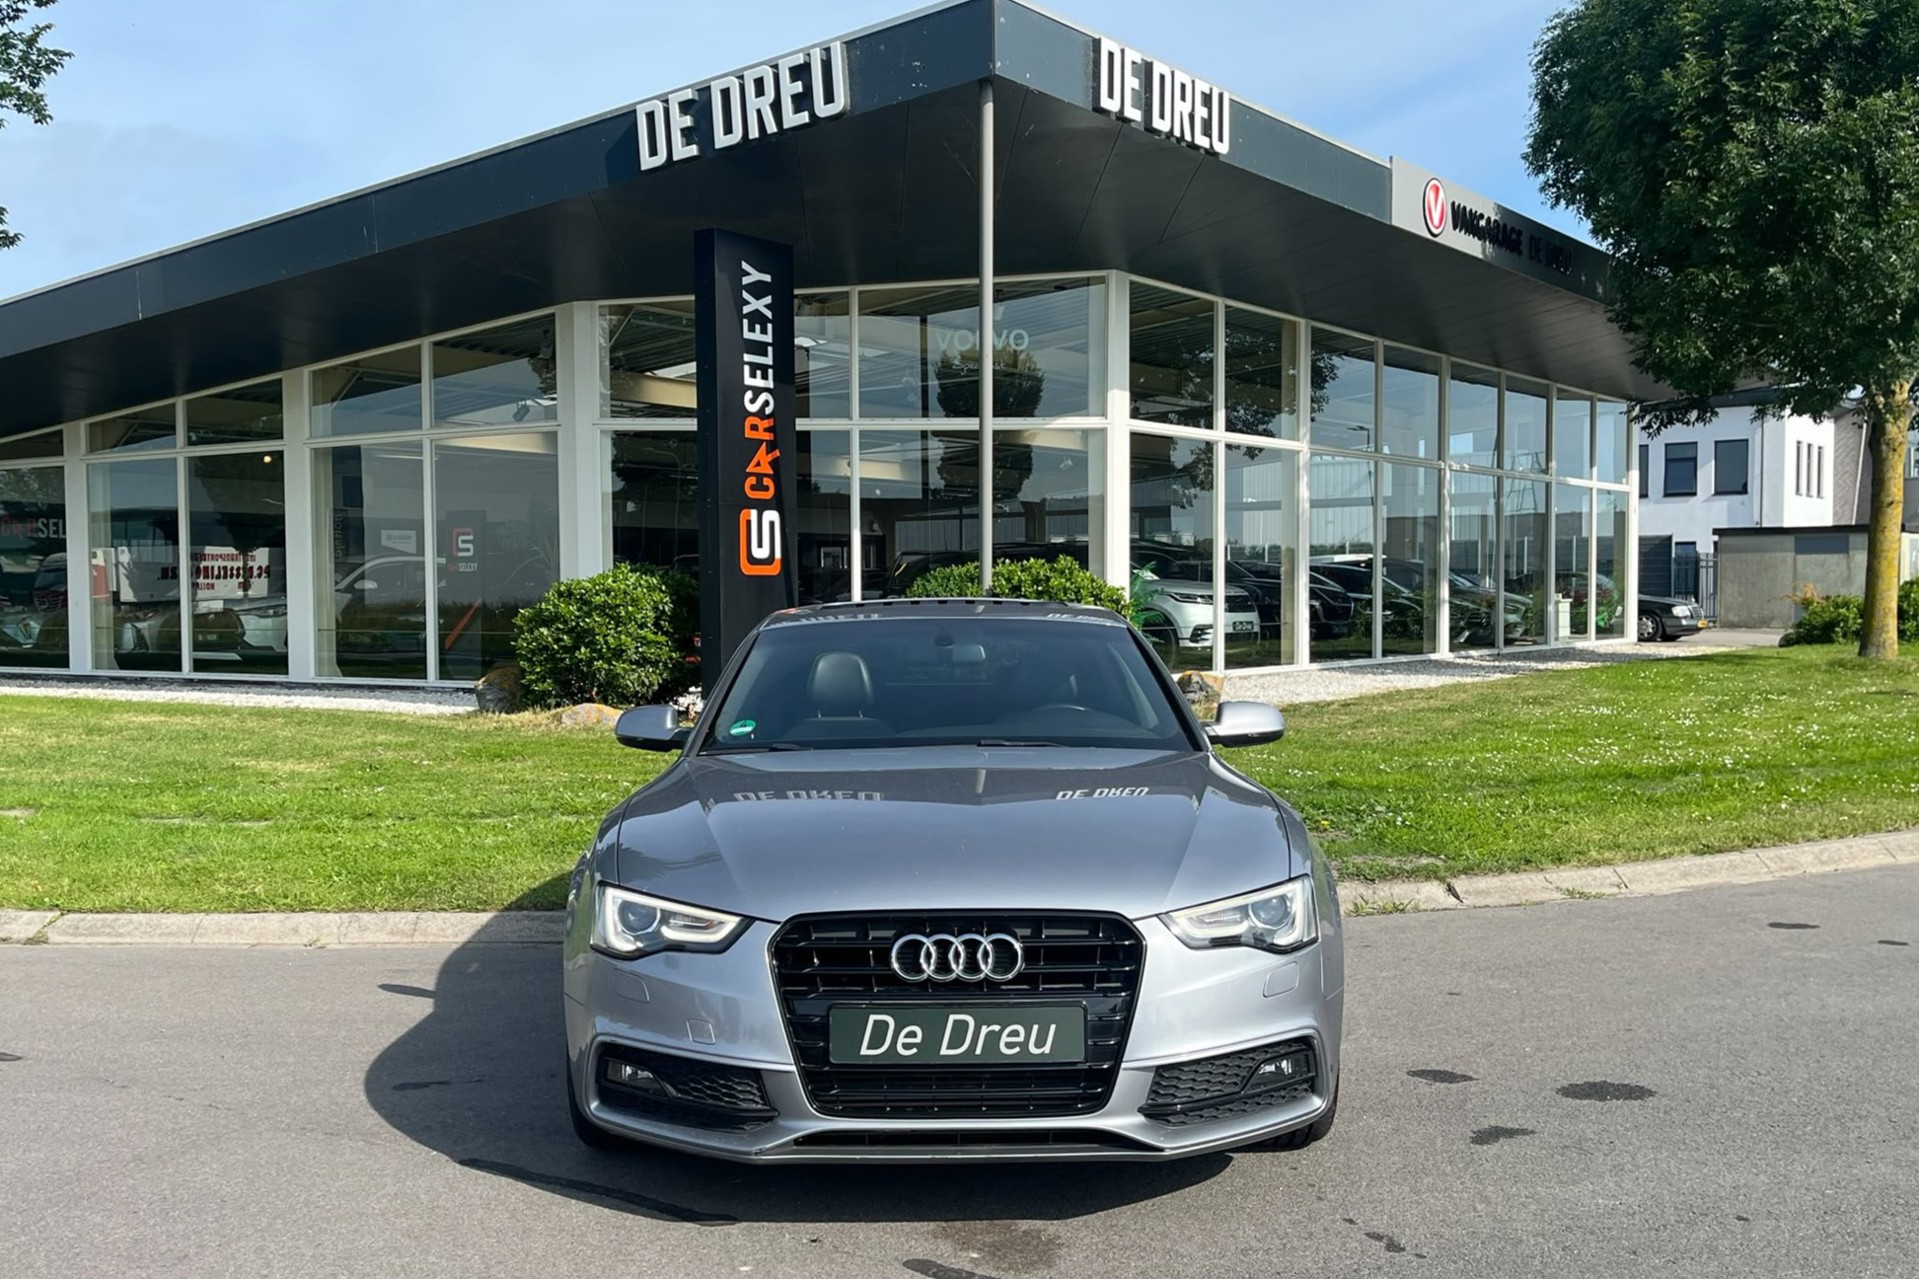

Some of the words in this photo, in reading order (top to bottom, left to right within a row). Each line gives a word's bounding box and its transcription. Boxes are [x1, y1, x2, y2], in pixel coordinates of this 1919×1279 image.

[636, 98, 699, 172] DE
[710, 41, 850, 150] DREU
[1100, 36, 1142, 122] DE
[1152, 59, 1230, 154] DREU
[741, 259, 781, 500] CARSELEXY
[936, 329, 1029, 351] VOVO
[859, 1013, 923, 1056] De
[939, 1013, 1057, 1056] Dreu
